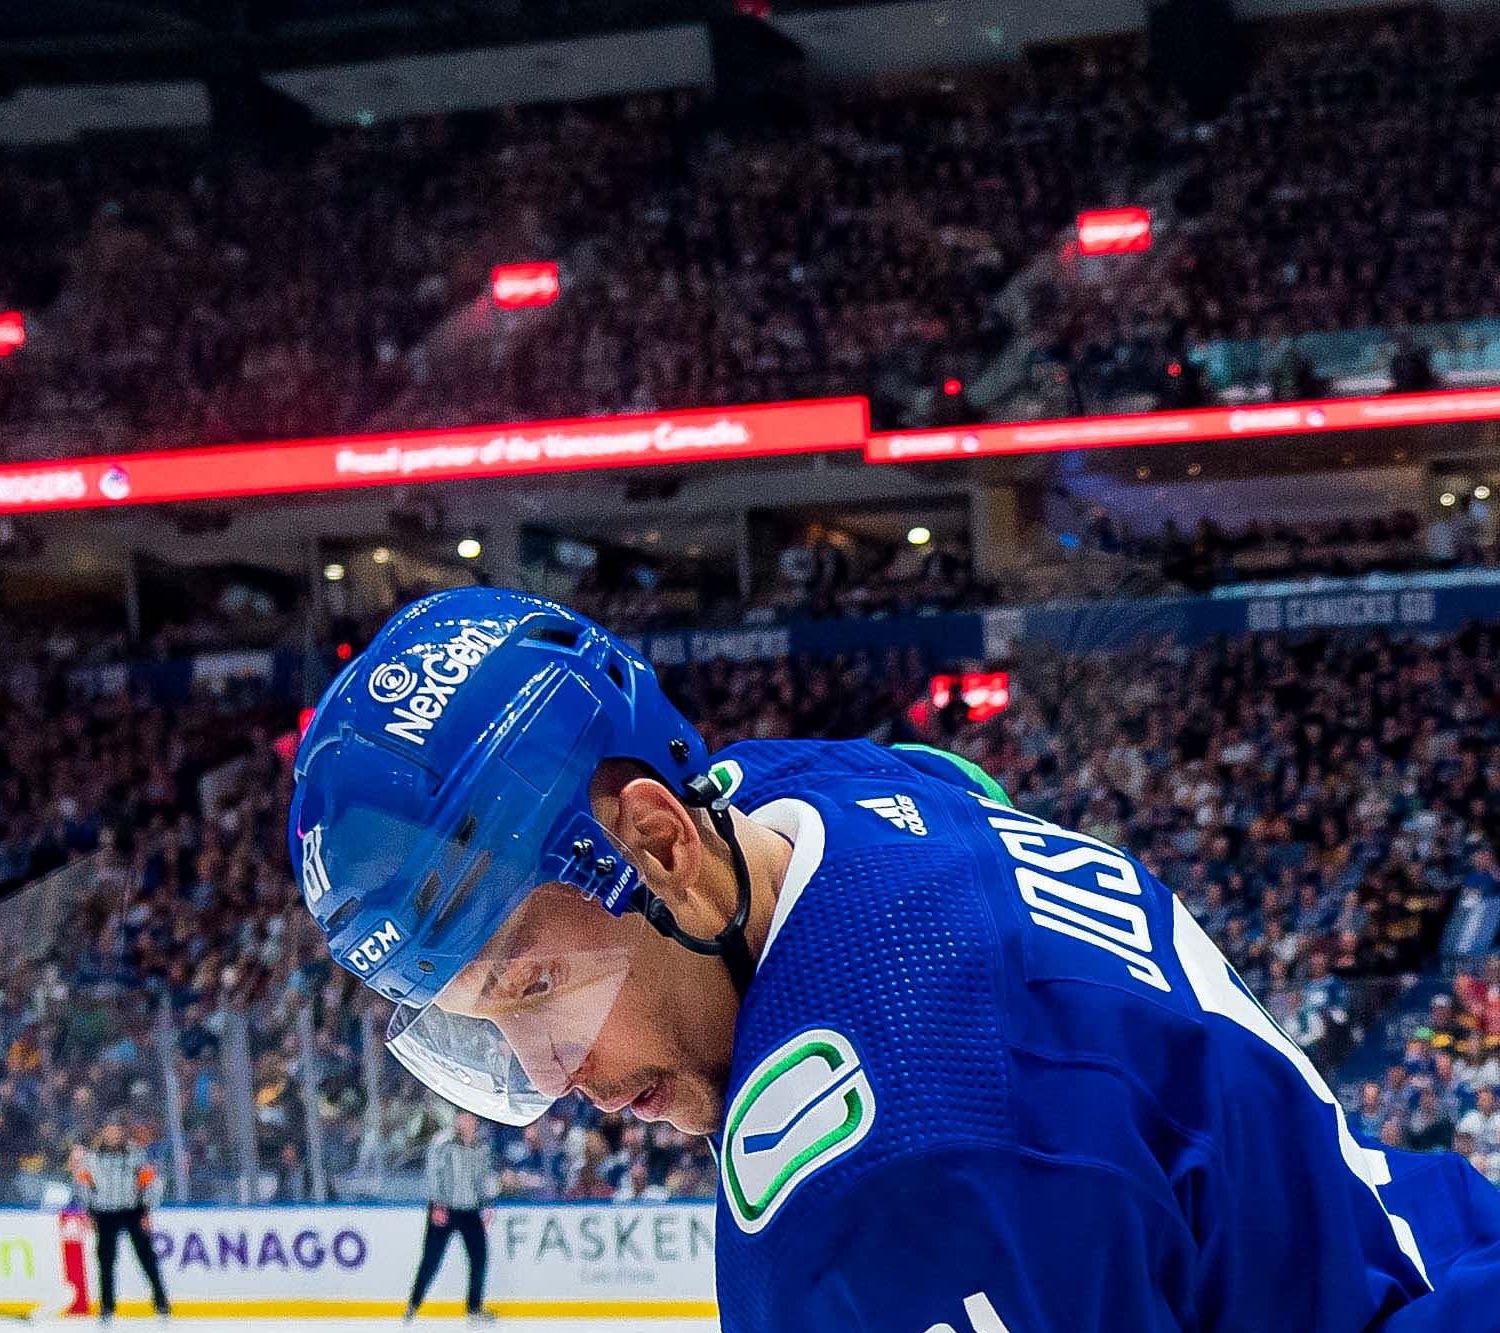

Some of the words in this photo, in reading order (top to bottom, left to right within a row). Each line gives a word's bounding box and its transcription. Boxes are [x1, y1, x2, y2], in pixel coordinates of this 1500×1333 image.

[384, 624, 500, 746] NexGen
[604, 864, 635, 910] BAUER
[967, 790, 1171, 993] JOSH
[346, 919, 402, 974] CCM
